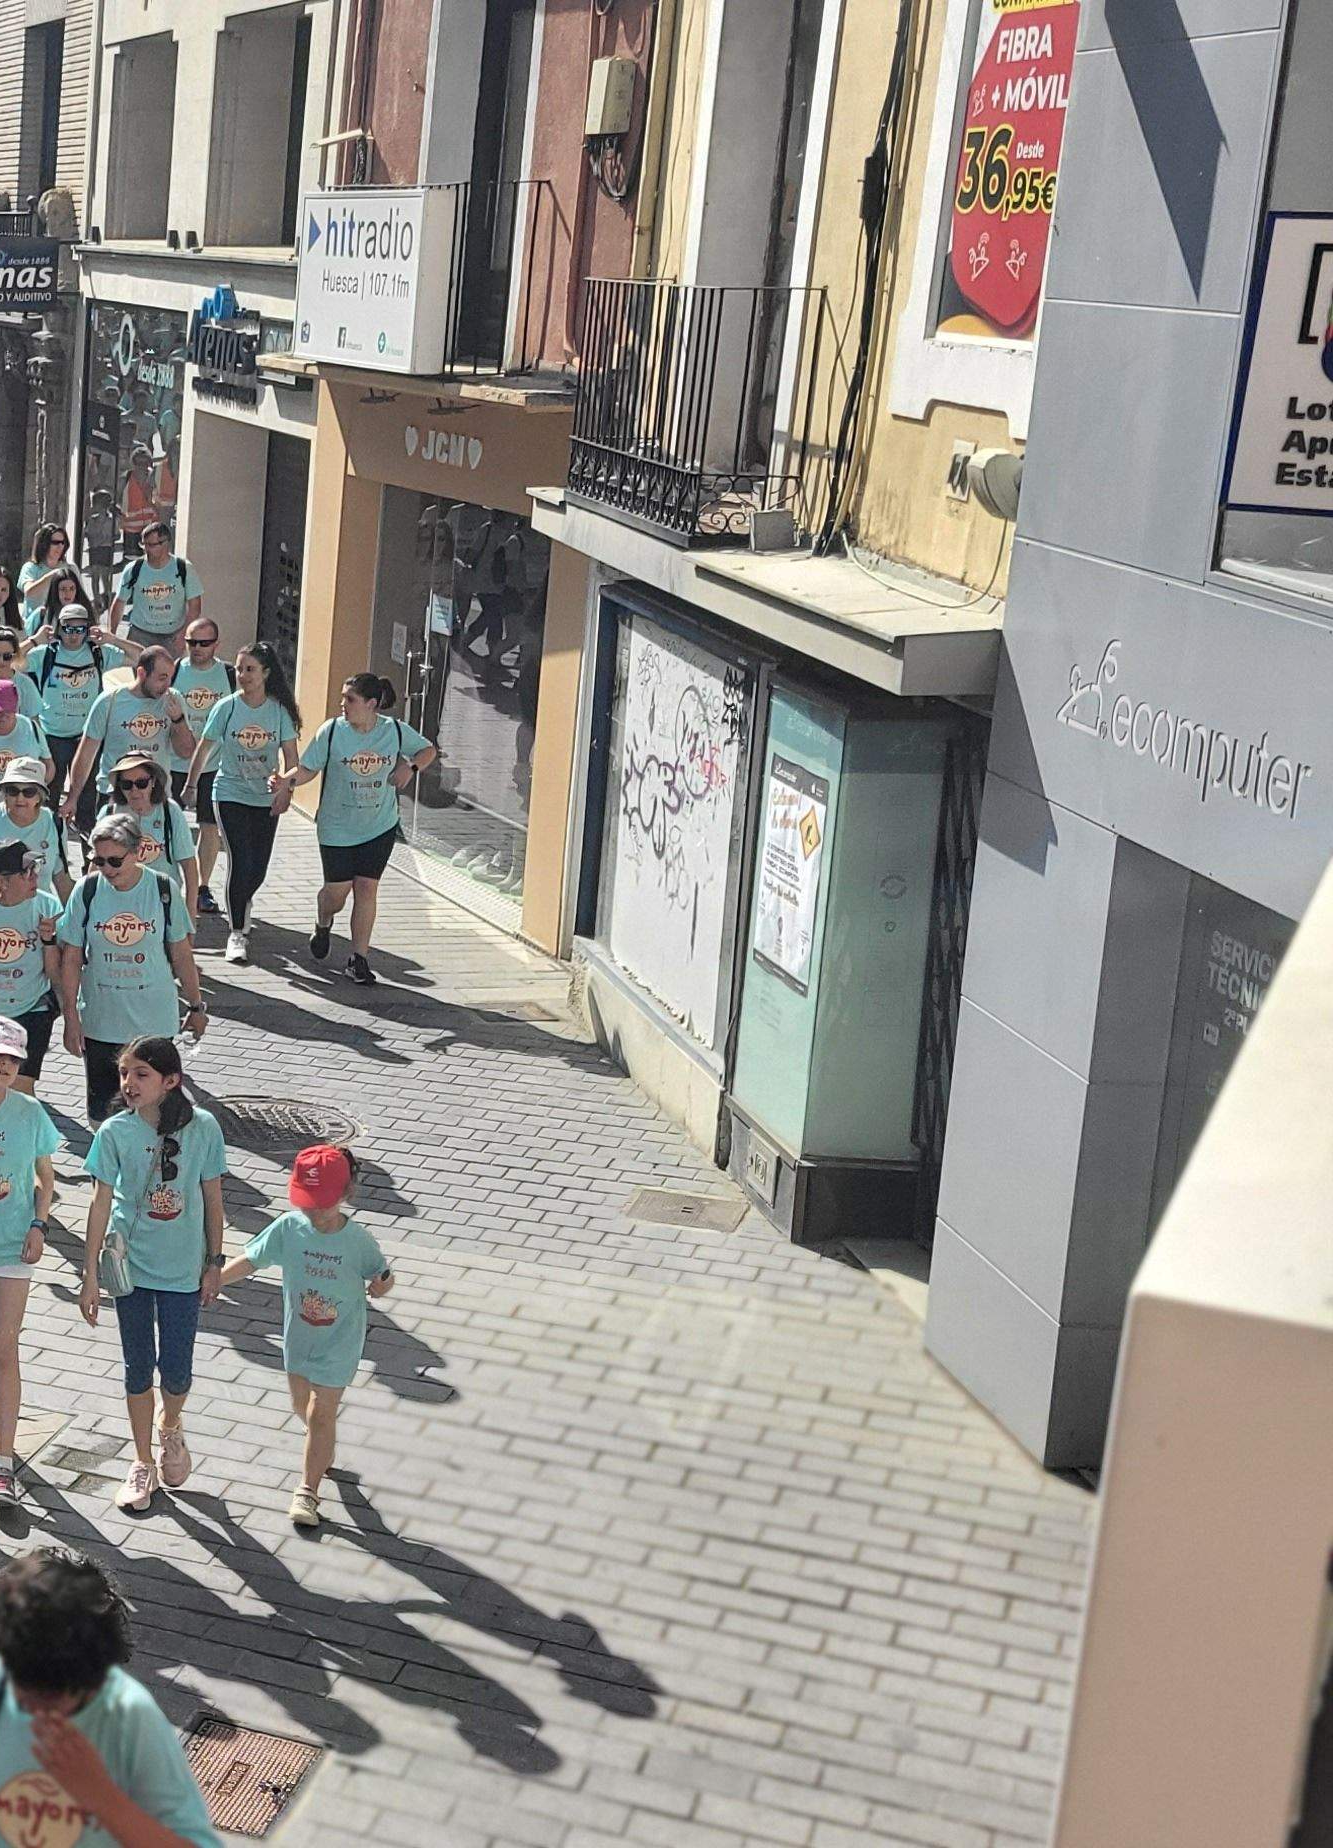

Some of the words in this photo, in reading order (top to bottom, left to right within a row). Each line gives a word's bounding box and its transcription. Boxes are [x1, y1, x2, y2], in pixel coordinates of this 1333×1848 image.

[996, 24, 1053, 64] FIBRA
[1003, 67, 1069, 113] MÓVIL
[1015, 140, 1045, 160] Desde
[325, 208, 414, 262] hitradio
[8, 256, 30, 266] desde
[6, 292, 12, 302] Y
[13, 292, 52, 302] AUDITIVO
[322, 269, 359, 295] Huesca
[369, 272, 411, 299] 107.1fm
[421, 429, 466, 468] JCM
[1111, 691, 1312, 820] ecomputer
[94, 919, 156, 938] +mayores
